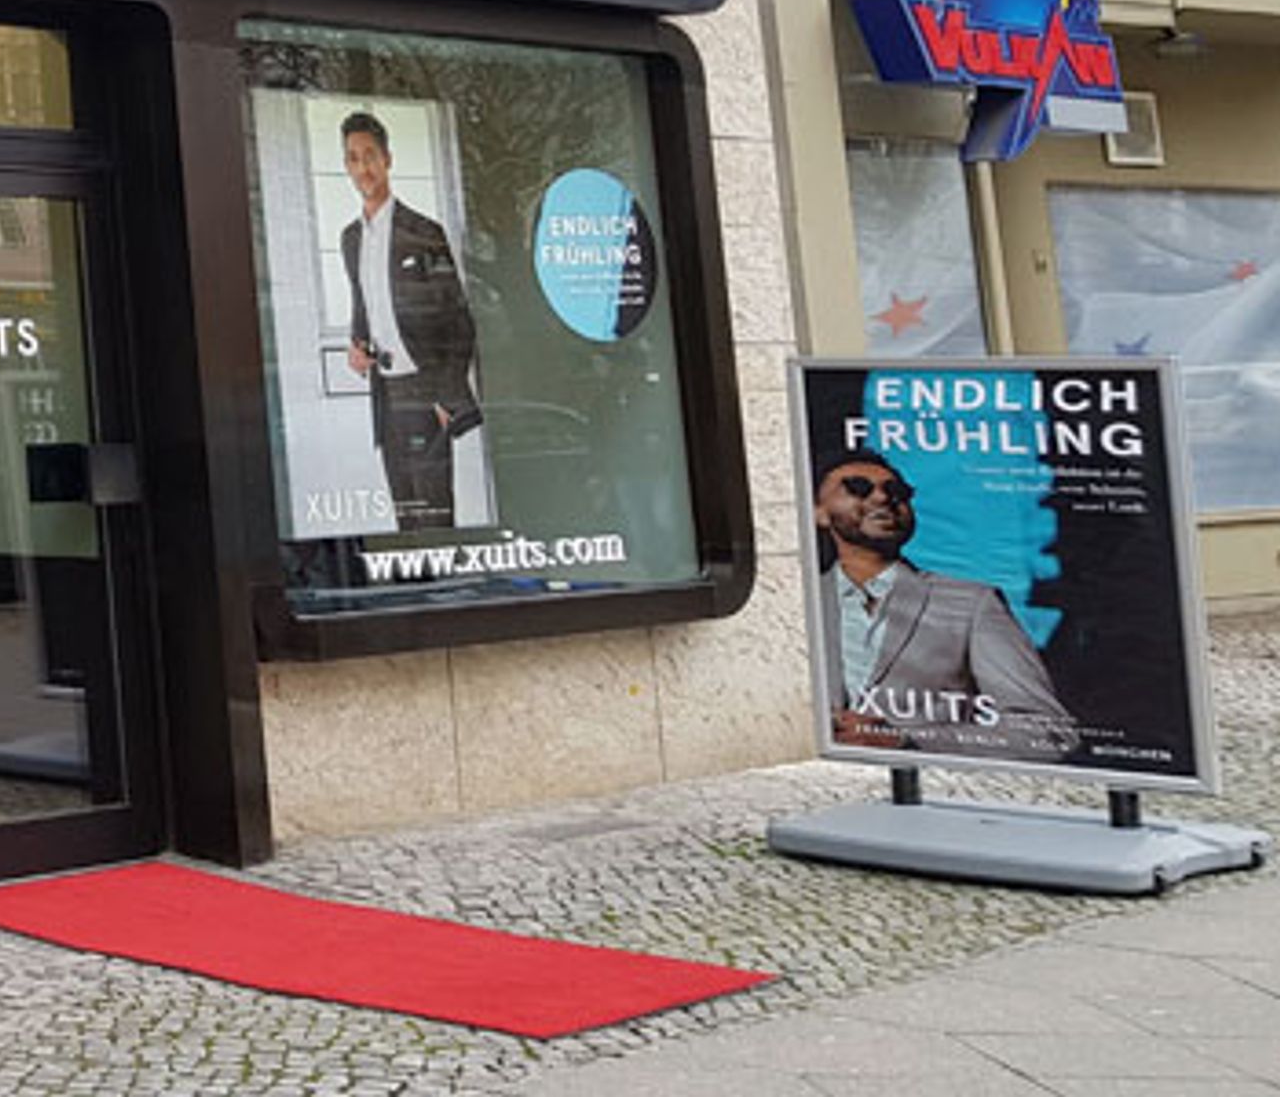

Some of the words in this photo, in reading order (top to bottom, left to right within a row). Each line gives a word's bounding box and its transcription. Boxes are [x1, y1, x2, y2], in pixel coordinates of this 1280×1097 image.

[549, 214, 638, 236] ENDLICH
[542, 241, 642, 265] FRÜHLING
[875, 378, 1138, 413] ENDLICH
[843, 411, 1145, 457] FRÜHLING
[305, 488, 390, 523] XUITS
[359, 529, 628, 582] www.xuits.com
[857, 686, 1001, 727] XUITS
